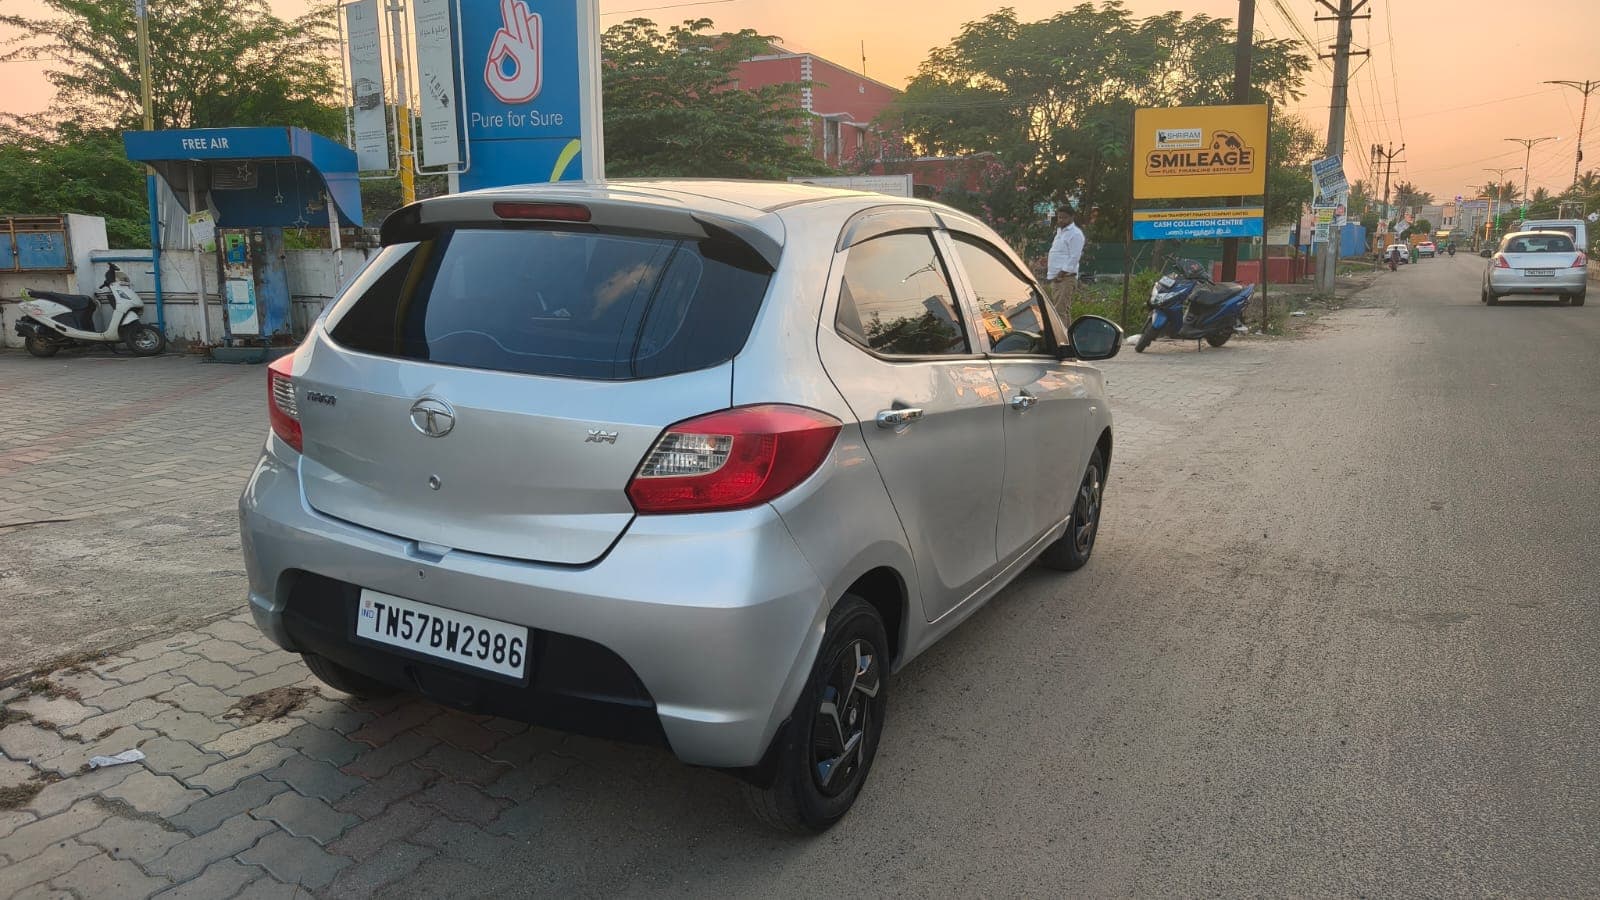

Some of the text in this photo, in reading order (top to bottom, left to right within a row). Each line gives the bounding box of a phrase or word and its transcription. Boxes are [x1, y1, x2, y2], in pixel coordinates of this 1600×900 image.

[471, 110, 563, 128] Pure for Sure
[182, 137, 229, 150] FREE AIR
[1150, 151, 1251, 168] SMILEAGE
[1173, 219, 1216, 227] COLLECTION
[1216, 218, 1243, 226] CENTRE
[361, 608, 375, 619] IND
[374, 602, 523, 668] TN57BW2986
